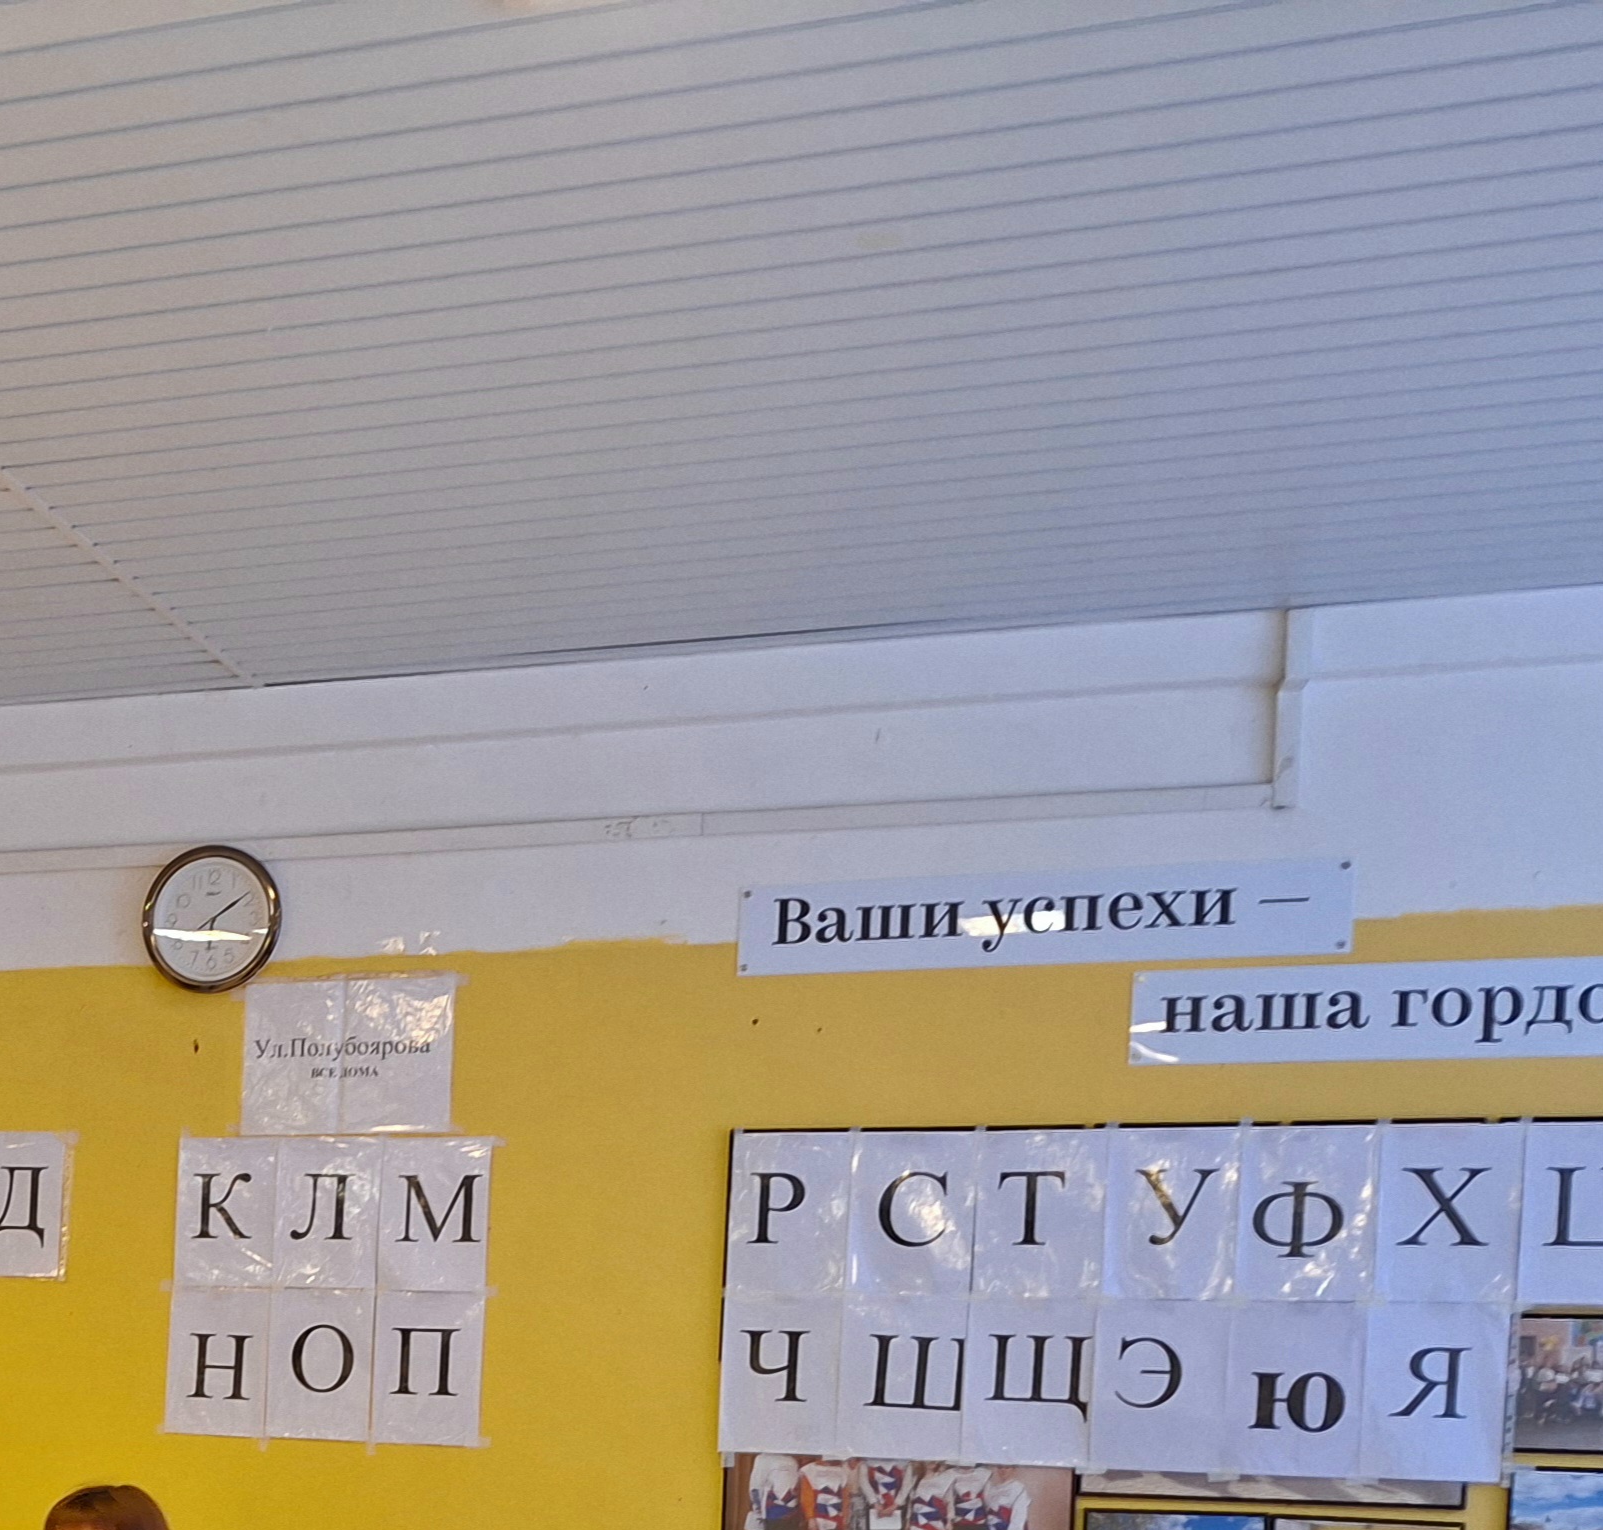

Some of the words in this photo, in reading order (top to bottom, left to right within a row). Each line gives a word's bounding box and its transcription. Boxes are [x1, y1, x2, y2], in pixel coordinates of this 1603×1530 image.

[772, 898, 964, 945] Ваши
[982, 887, 1237, 953] успехи
[1161, 990, 1370, 1033] наша
